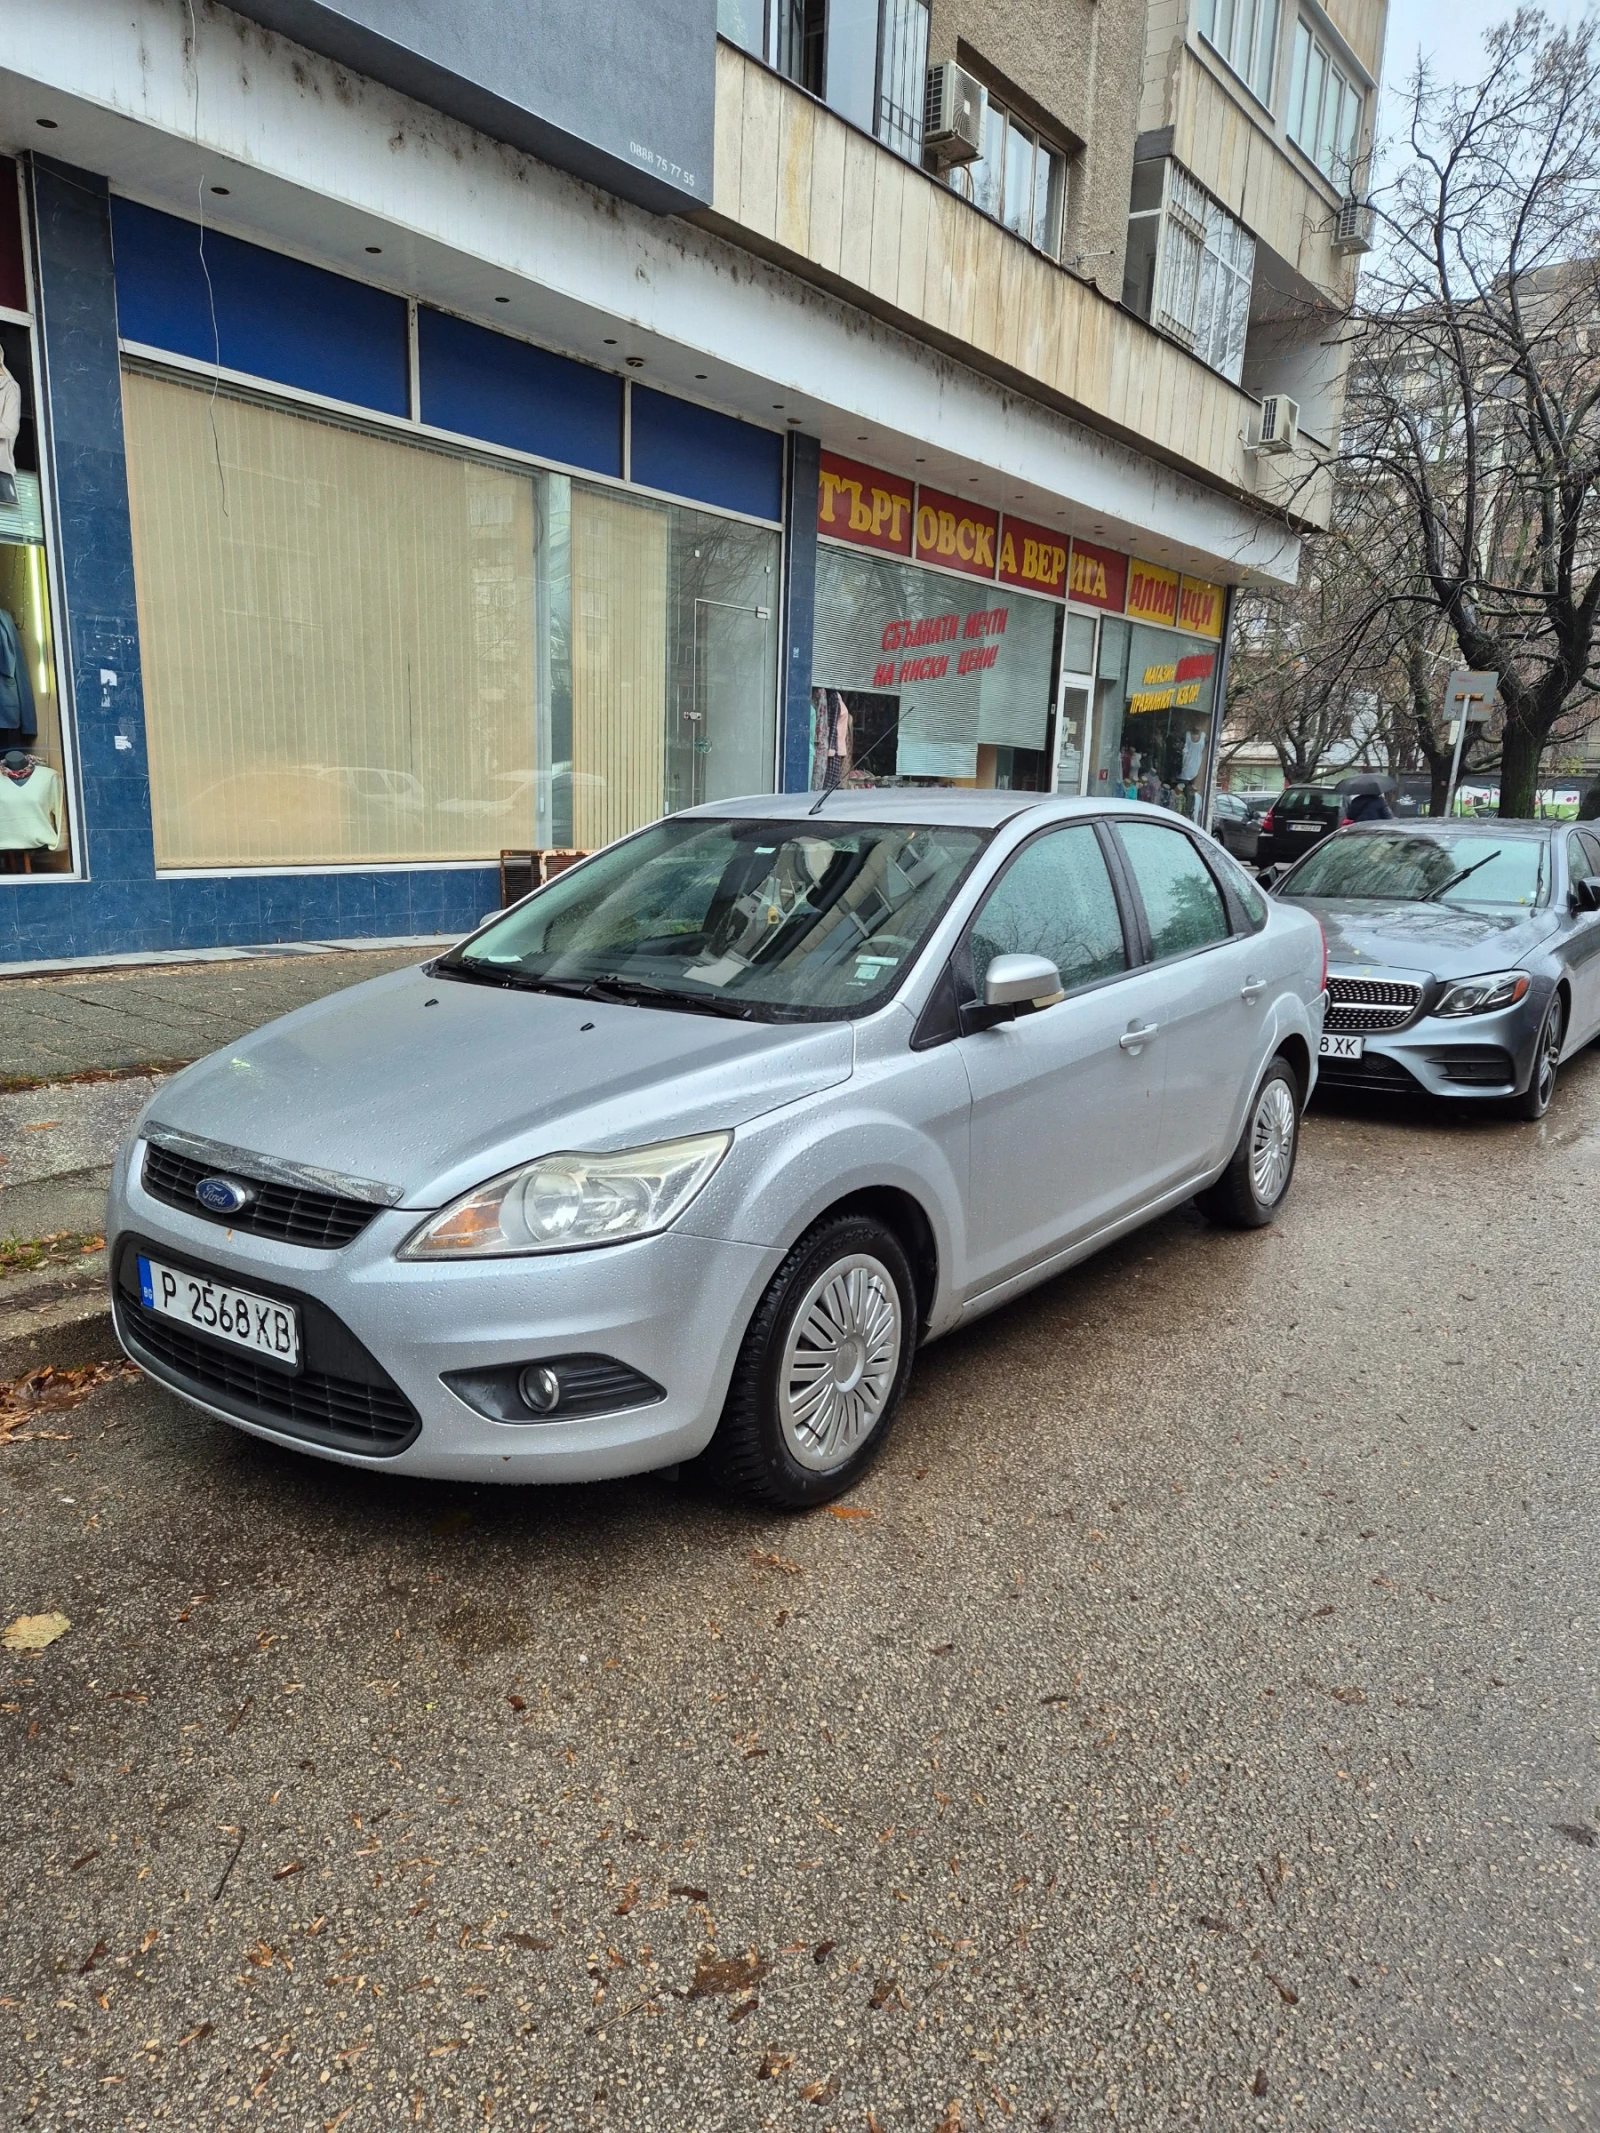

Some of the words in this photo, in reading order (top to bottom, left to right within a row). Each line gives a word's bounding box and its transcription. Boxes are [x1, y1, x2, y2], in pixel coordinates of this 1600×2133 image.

[630, 141, 654, 163] 0888
[656, 154, 668, 171] 75
[670, 163, 682, 178] 77
[683, 171, 695, 187] 55
[818, 470, 1017, 574] ТЪРГОВСКА
[1021, 538, 1108, 599] ВЕРИГА
[1129, 573, 1214, 630] АЛИАНЦИ
[882, 614, 960, 651] СБЪДНАТИ
[963, 608, 1009, 639] МЕЧТИ
[873, 662, 895, 687] НА
[899, 655, 949, 683] НИСКИ
[202, 1184, 227, 1206] Ford
[143, 1286, 153, 1300] BG
